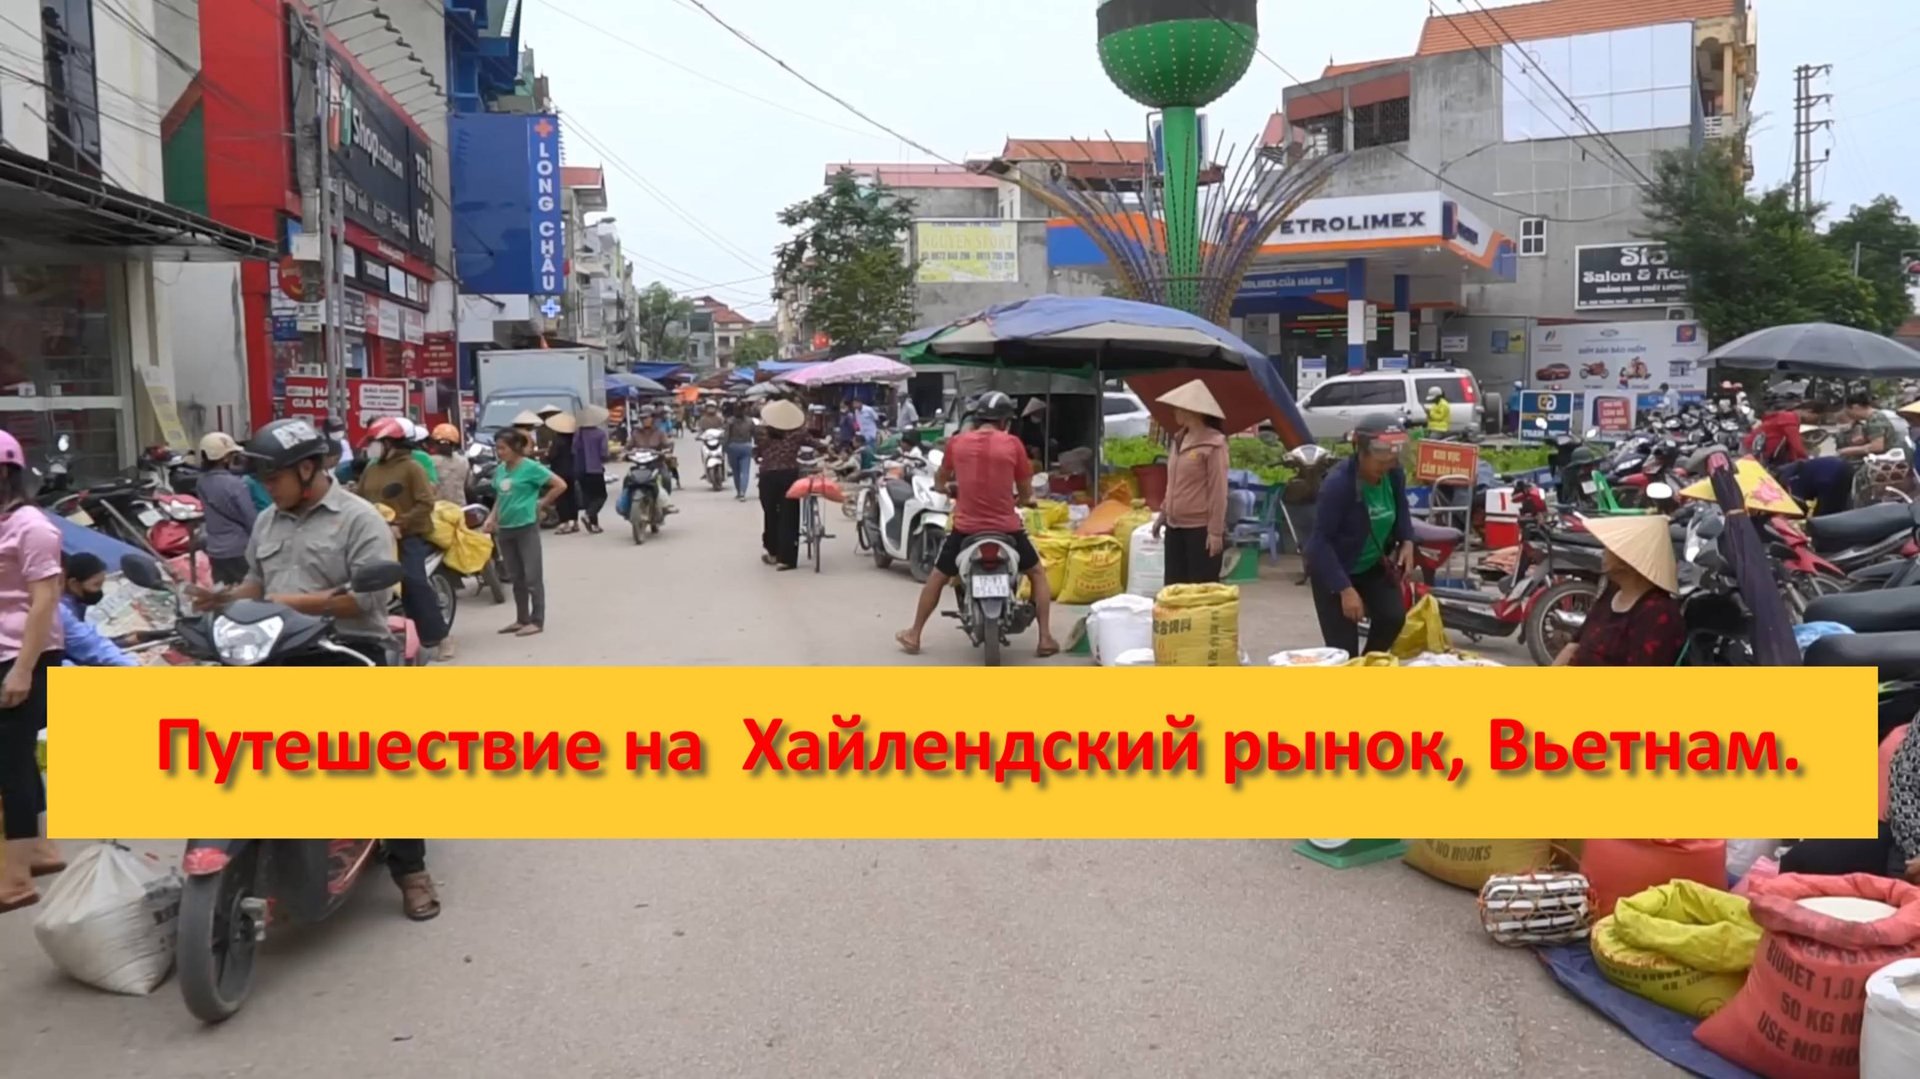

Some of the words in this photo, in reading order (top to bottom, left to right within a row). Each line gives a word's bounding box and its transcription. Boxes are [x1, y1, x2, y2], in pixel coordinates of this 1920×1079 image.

[537, 142, 554, 212] LONG
[1280, 212, 1426, 235] ETROLIMEX
[539, 221, 555, 291] CHÂU
[1582, 270, 1632, 284] Salon
[1637, 268, 1651, 281] &
[292, 398, 313, 408] GIA
[1451, 845, 1492, 861] HOOKS
[1766, 939, 1816, 991] BIURET
[1823, 976, 1855, 1000] 1.0
[1780, 992, 1801, 1022] 50
[1806, 1006, 1835, 1034] KG
[1757, 1011, 1789, 1050] USE
[1792, 1036, 1823, 1064] NO
